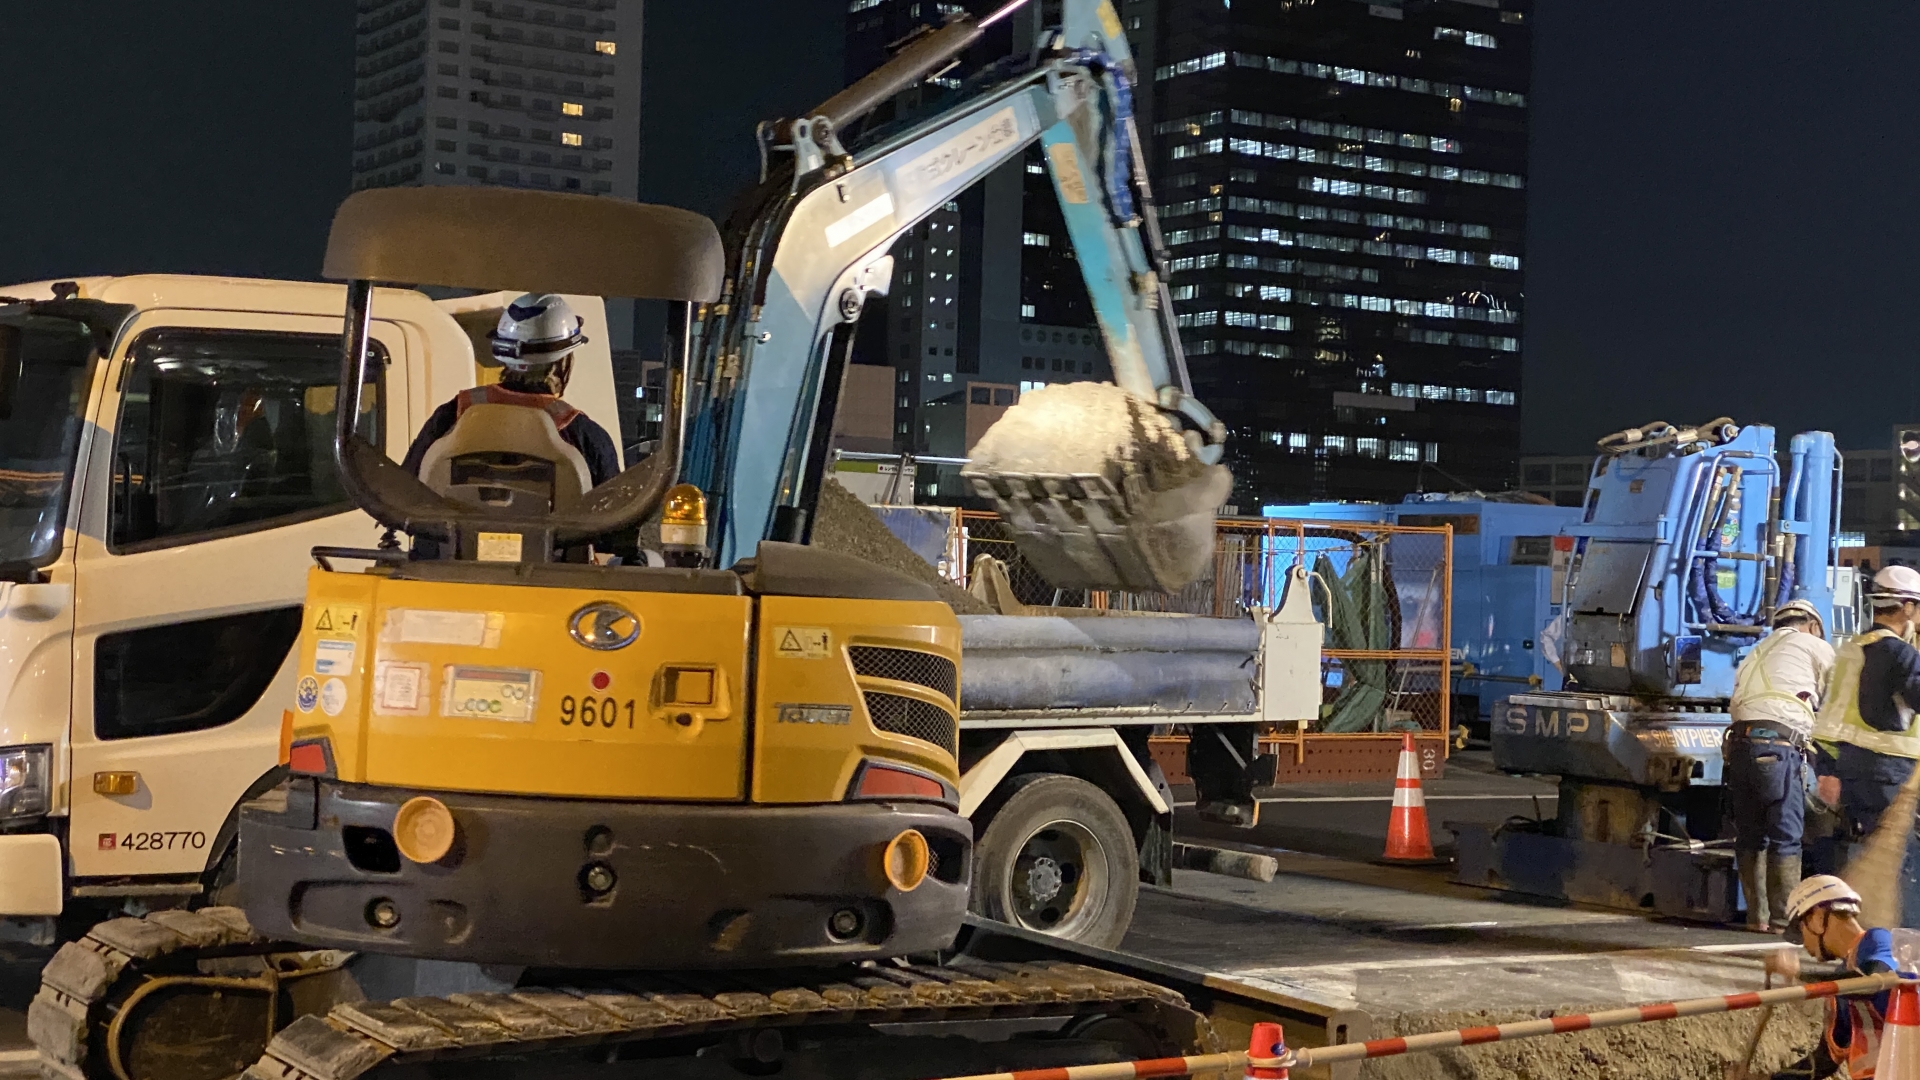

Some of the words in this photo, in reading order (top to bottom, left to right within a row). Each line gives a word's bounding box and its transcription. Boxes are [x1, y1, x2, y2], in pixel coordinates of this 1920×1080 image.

[560, 695, 635, 729] 9601
[1505, 707, 1589, 738] SMP
[1423, 748, 1436, 770] 30
[121, 831, 206, 850] 428770
